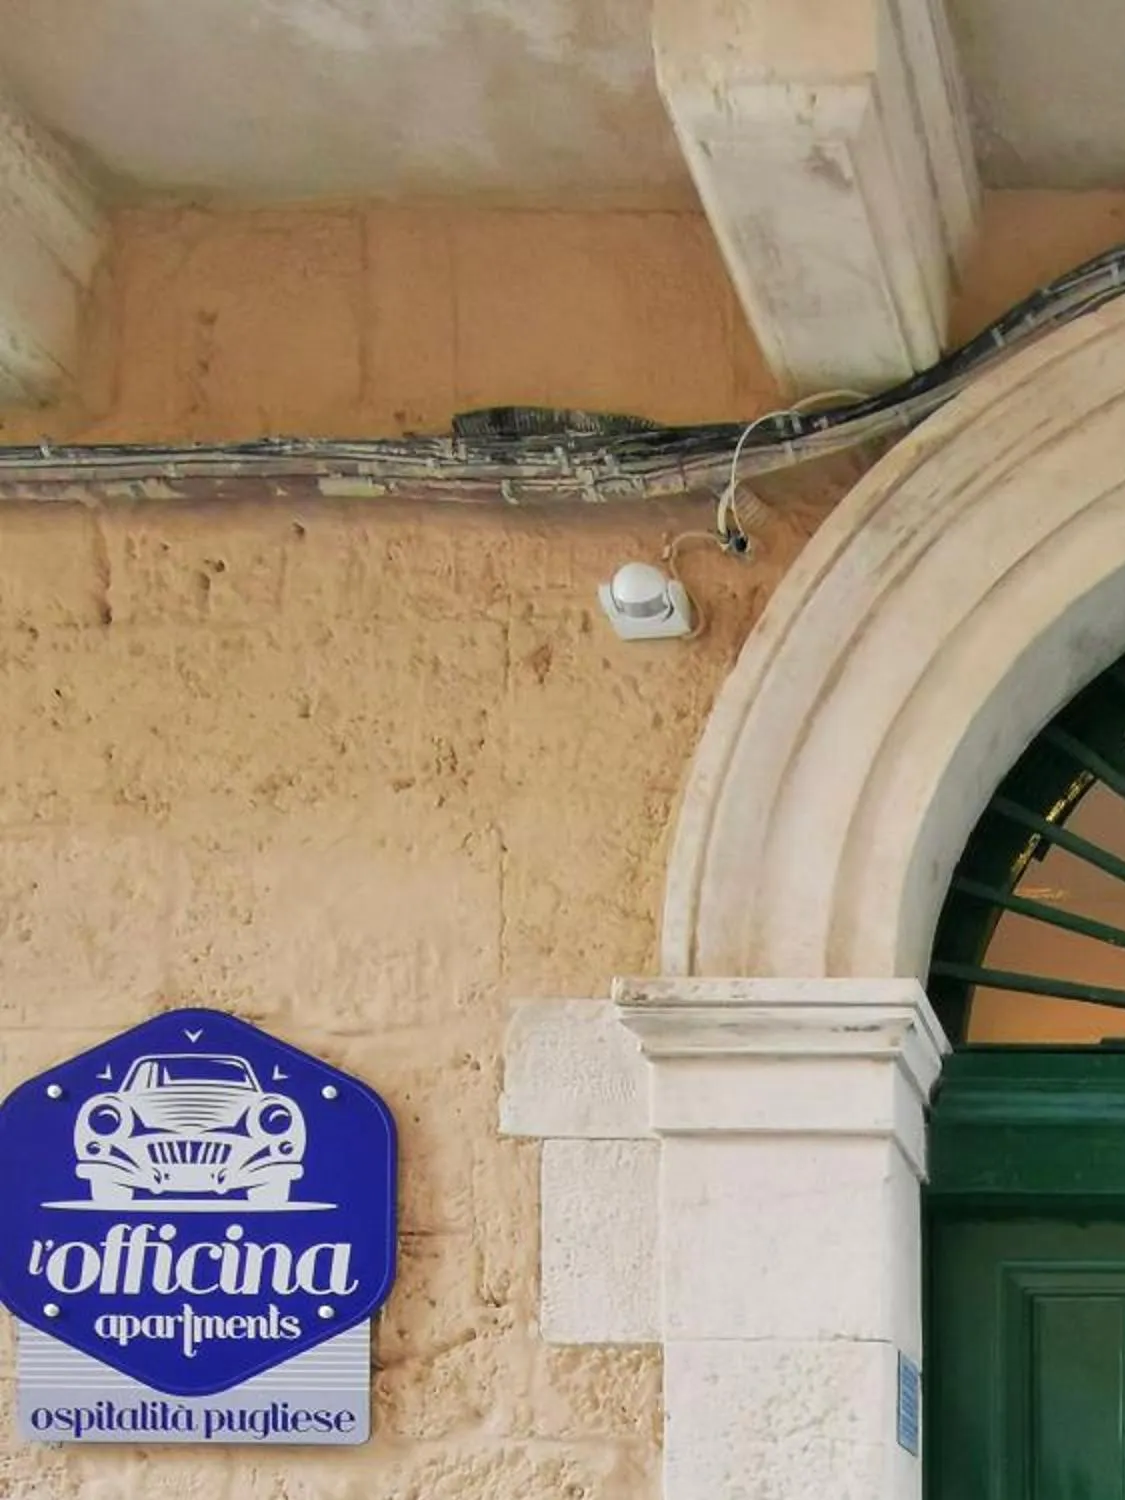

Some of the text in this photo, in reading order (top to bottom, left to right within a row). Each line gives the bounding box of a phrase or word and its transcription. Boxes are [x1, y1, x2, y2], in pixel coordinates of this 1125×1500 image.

[95, 1304, 301, 1357] apartments
[31, 1402, 356, 1440] ospitalità pugliese
